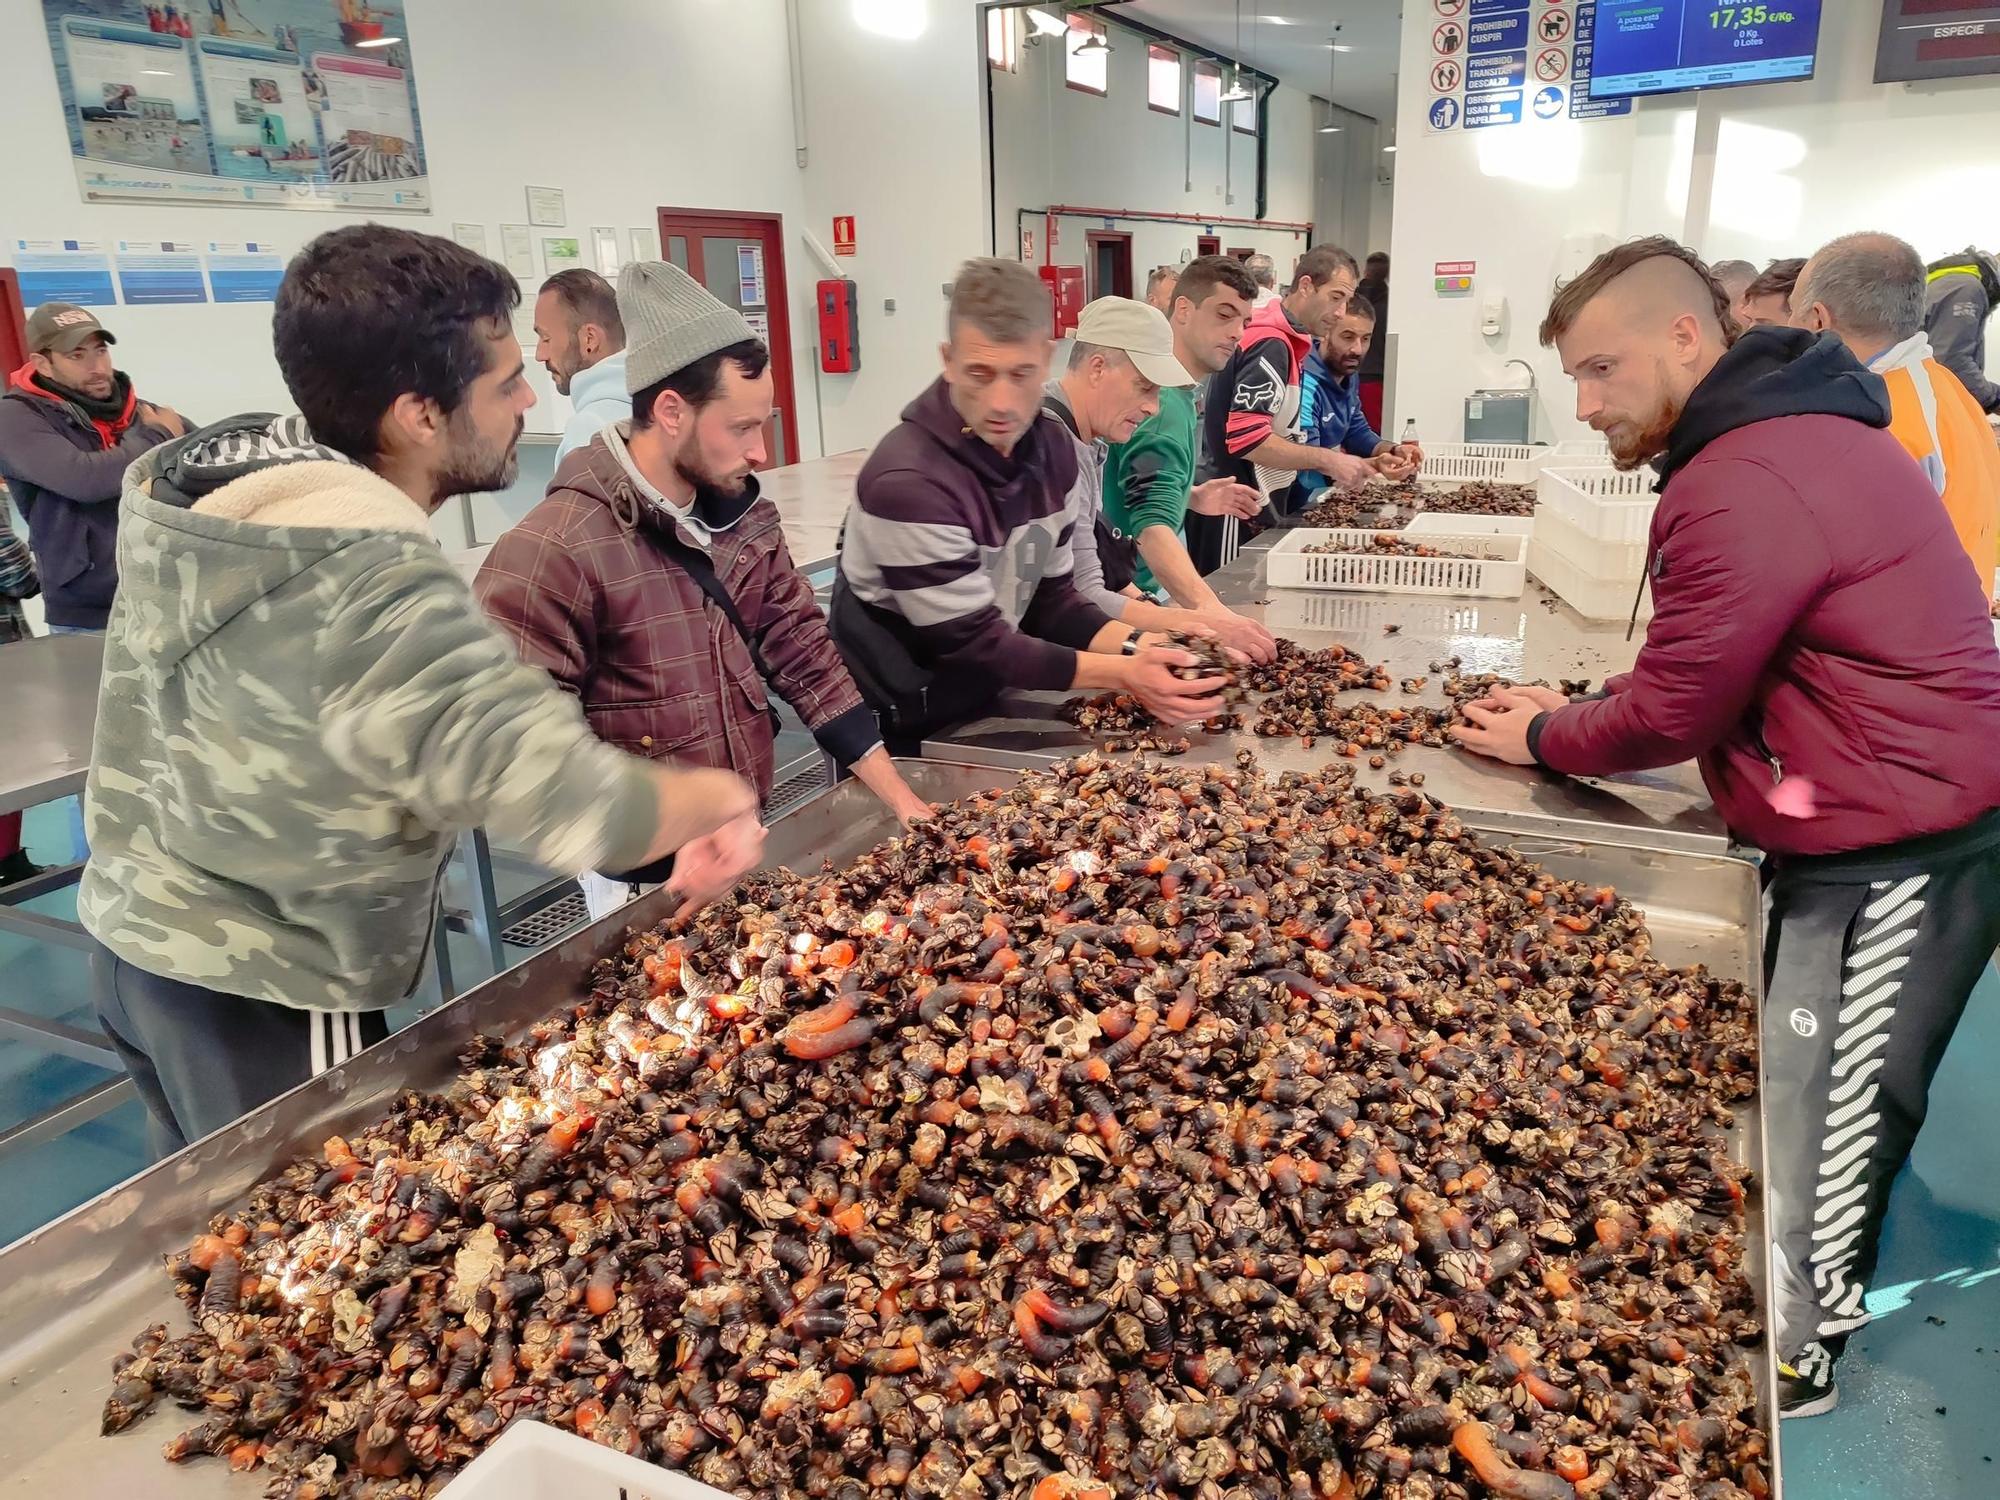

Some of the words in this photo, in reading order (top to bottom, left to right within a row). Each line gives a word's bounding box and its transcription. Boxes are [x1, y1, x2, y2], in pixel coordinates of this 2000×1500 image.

[1624, 16, 1643, 25] poxa
[1643, 14, 1660, 22] está
[1710, 5, 1767, 29] 17,35
[1471, 19, 1518, 32] PROHIBIDO
[1579, 19, 1586, 27] A
[1578, 30, 1590, 39] DE
[1739, 30, 1745, 38] 0
[1934, 24, 1985, 38] ESPECIE
[1471, 32, 1502, 43] CUSPIR
[1733, 39, 1740, 48] 0
[1740, 38, 1764, 47] Lotes
[1470, 55, 1513, 68] PROHIBIDO
[1468, 77, 1510, 88] DESCALZO
[1466, 105, 1489, 115] USAR
